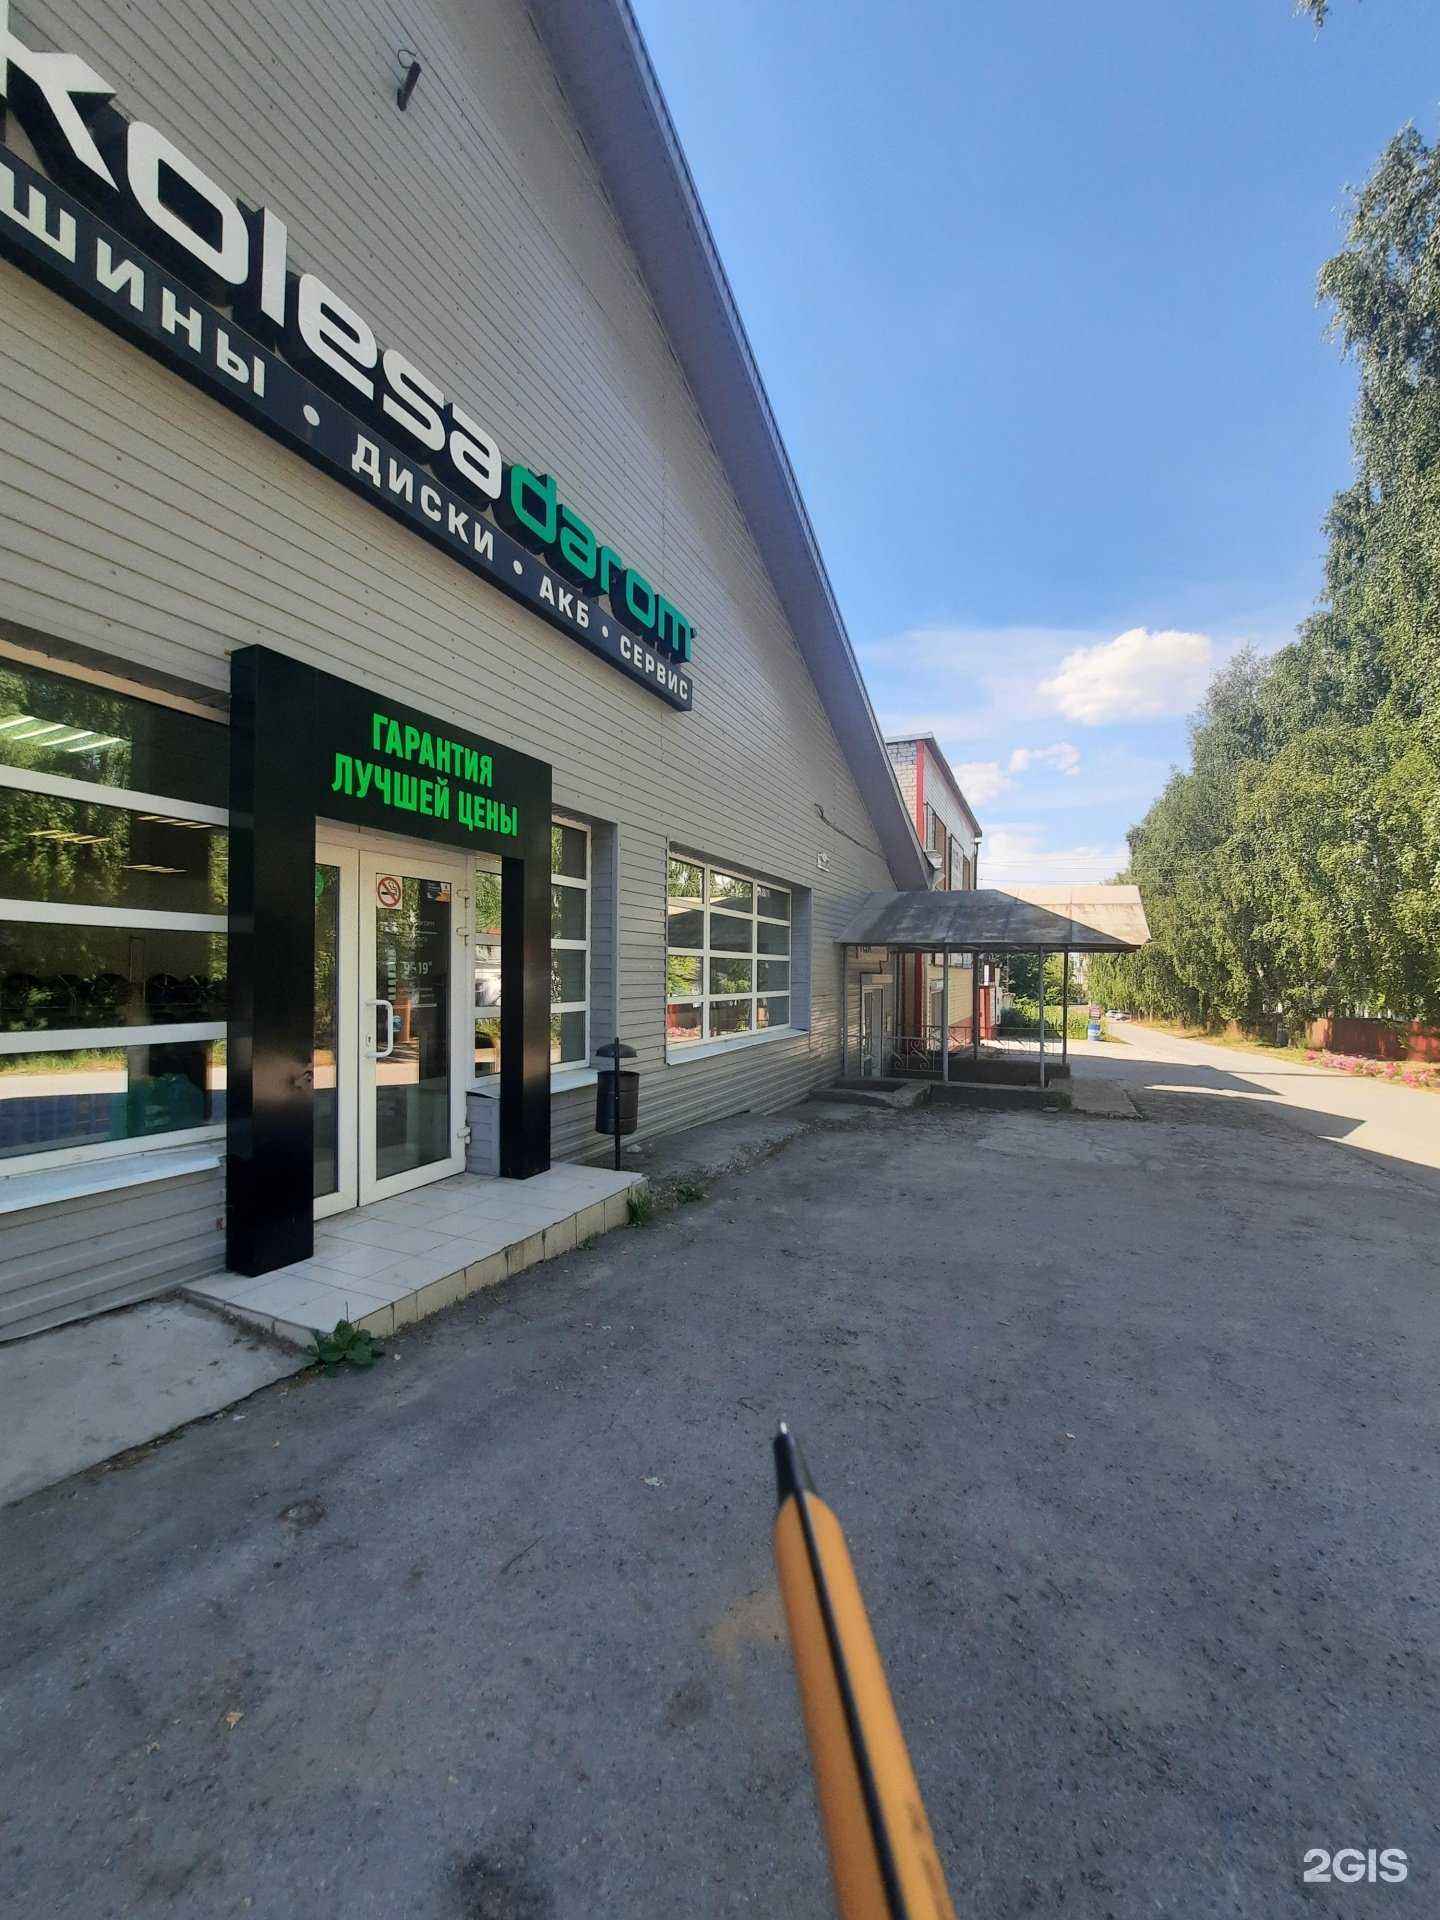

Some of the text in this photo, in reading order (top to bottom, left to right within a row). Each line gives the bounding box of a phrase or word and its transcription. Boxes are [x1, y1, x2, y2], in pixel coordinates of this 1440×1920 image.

[0, 162, 689, 701] ШИНЫ ДИСКИ АКБ СЕРВИС
[372, 712, 494, 788] ГАРАНТИЯ
[331, 752, 518, 837] ЛУЧШЕЙ ЦЕНЫ
